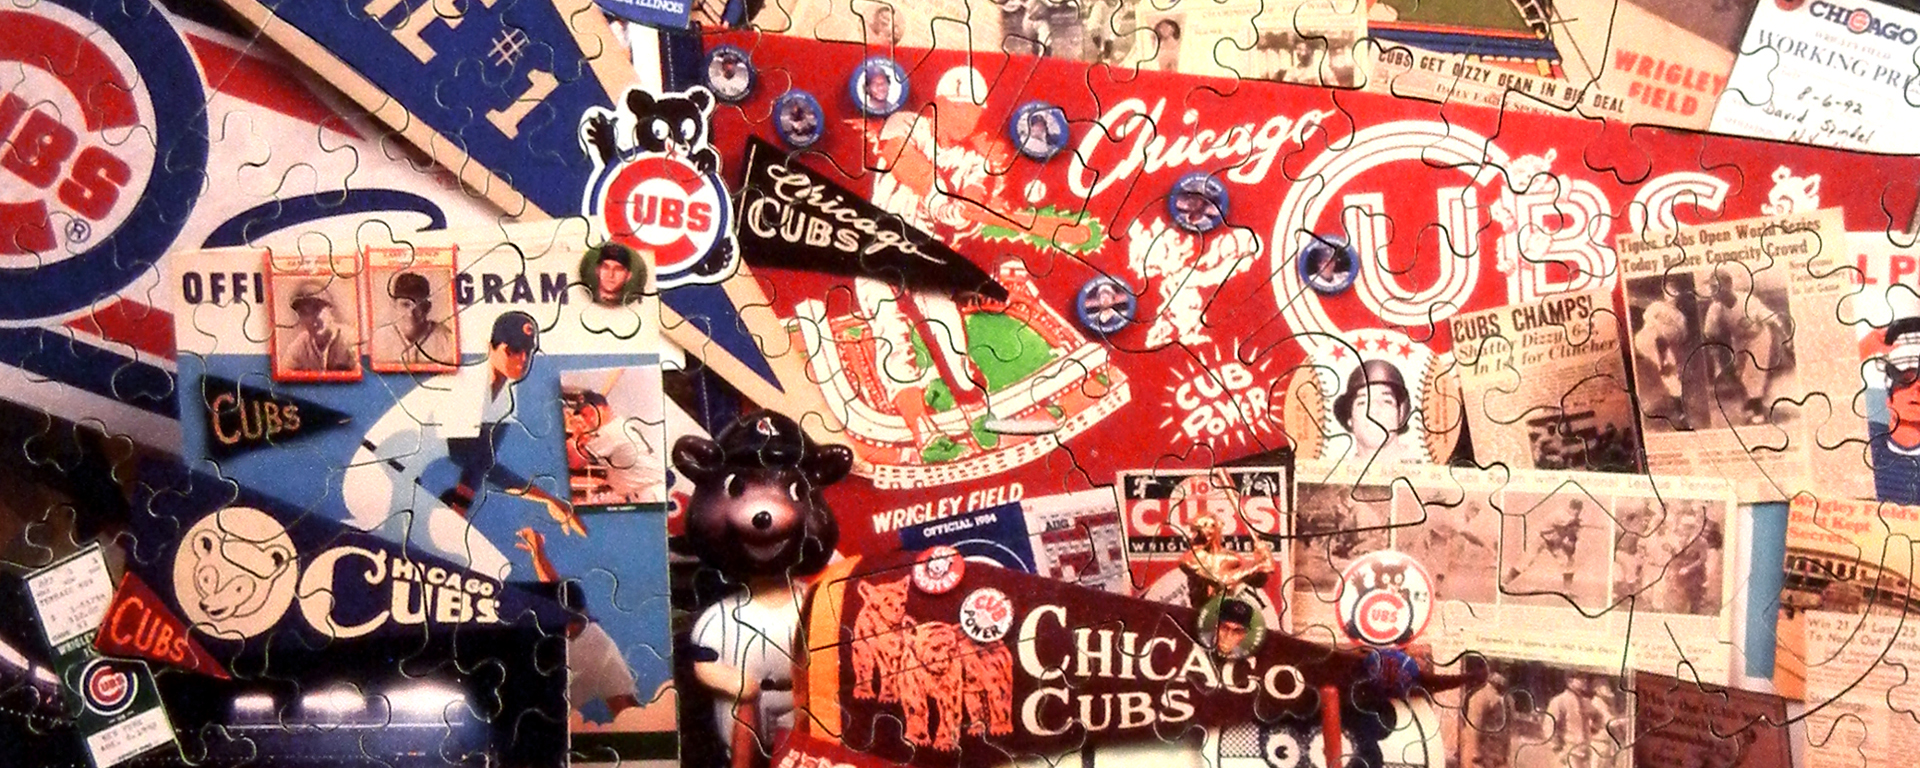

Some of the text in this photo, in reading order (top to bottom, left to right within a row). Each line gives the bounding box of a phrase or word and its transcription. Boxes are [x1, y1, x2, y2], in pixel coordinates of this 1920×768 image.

[1614, 47, 1728, 97] WRIGLEY
[1759, 29, 1868, 78] WORKING
[1378, 47, 1625, 114] CUBS GET DIZZY DEAN IN BIG DEAL
[1628, 81, 1699, 117] FIELD
[1068, 97, 1337, 198] Chicago
[748, 197, 860, 253] CUBS
[767, 164, 947, 265] Chicago
[1700, 228, 1732, 247] Open
[1621, 256, 1658, 273] Today
[1767, 239, 1809, 257] Crowd
[1453, 295, 1593, 343] CUBS CHAMPS!
[1522, 351, 1542, 365] for
[1176, 362, 1253, 410] CUB
[212, 392, 301, 445] CUBS
[1181, 387, 1269, 438] POWER
[872, 482, 1025, 534] WRIGLEY FIELD
[923, 519, 974, 538] OFFICIAL
[110, 595, 188, 662] CUBS
[964, 609, 1002, 639] POWER
[1017, 605, 1306, 700] CHICAGO
[1021, 687, 1195, 736] CUBS
